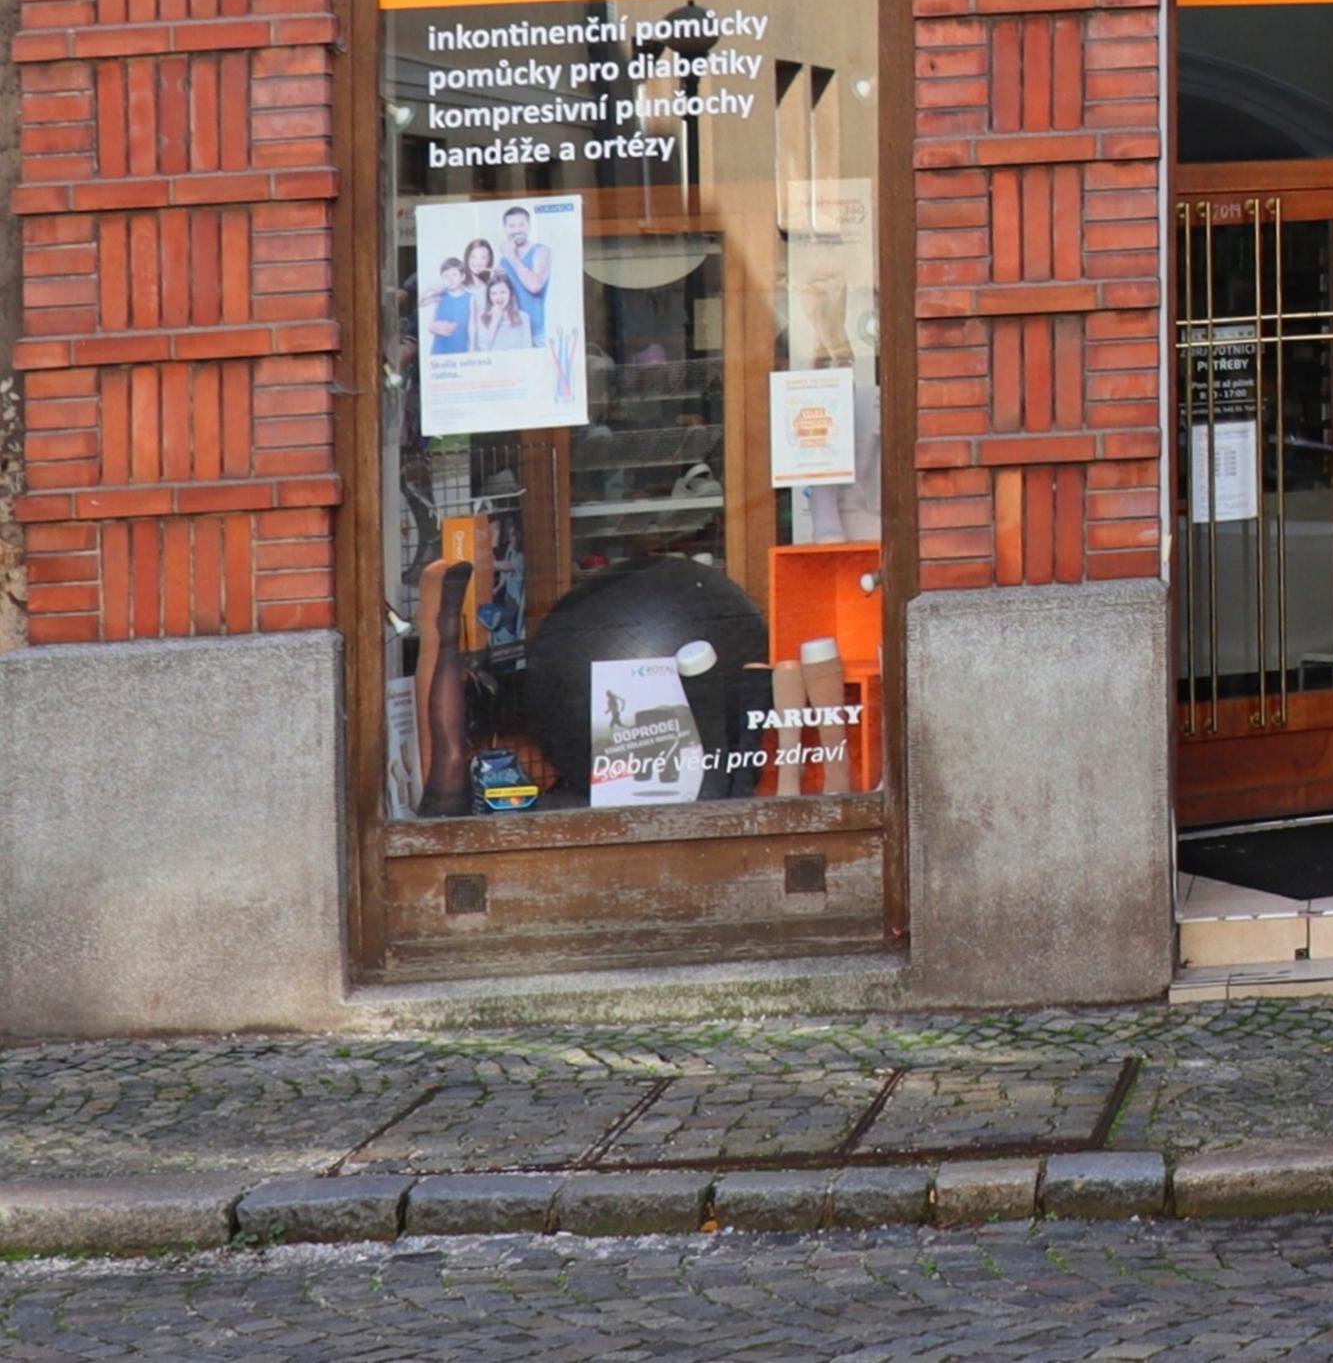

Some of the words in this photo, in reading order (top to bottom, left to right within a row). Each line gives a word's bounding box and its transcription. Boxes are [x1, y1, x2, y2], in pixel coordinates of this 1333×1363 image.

[428, 14, 627, 52] inkontinenční
[636, 10, 768, 48] pomůcky
[428, 60, 563, 97] pomůcky
[570, 61, 620, 89] pro
[628, 50, 762, 82] diabetiky
[428, 95, 606, 131] kompresivní
[615, 92, 755, 124] punčochy
[428, 129, 550, 168] bandáže
[560, 139, 577, 163] a
[583, 130, 676, 164] ortézy
[746, 705, 864, 730] PARUKY
[593, 751, 667, 777] Dobré
[672, 746, 722, 771] věci
[726, 750, 768, 772] pro
[775, 739, 848, 765] zdraví
